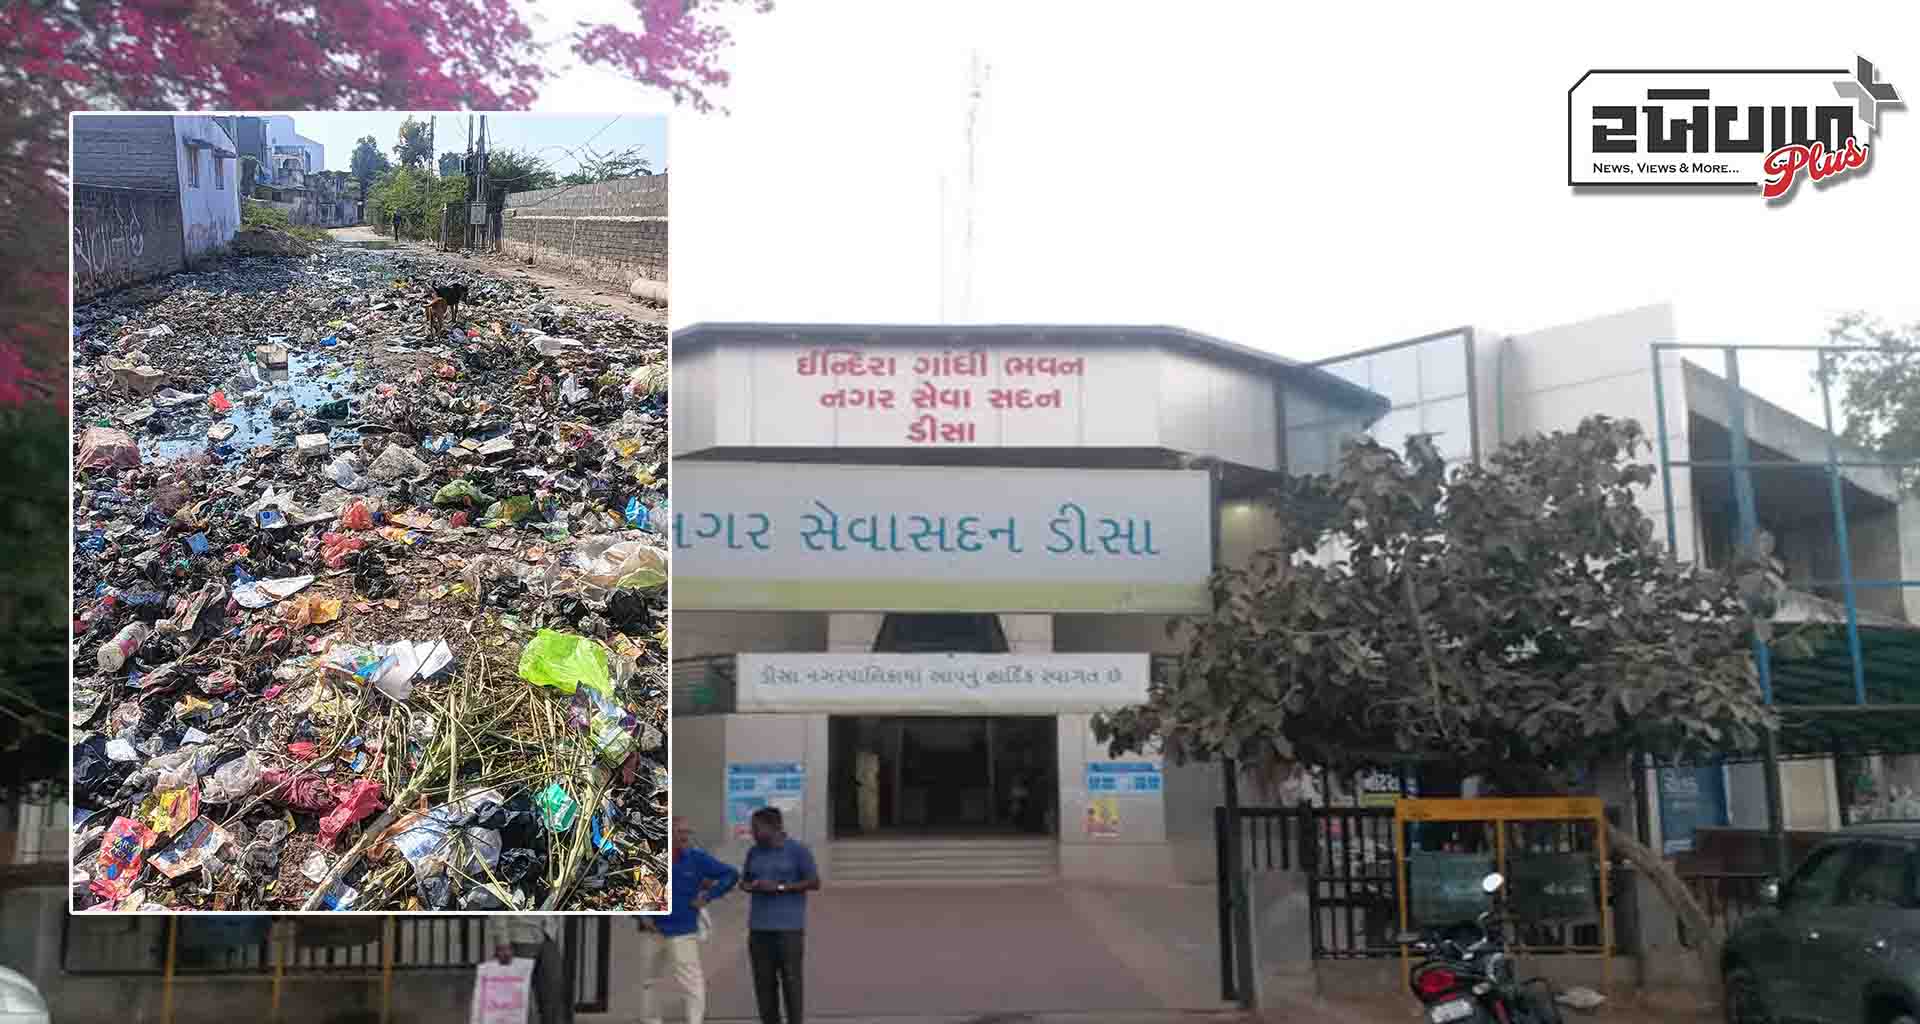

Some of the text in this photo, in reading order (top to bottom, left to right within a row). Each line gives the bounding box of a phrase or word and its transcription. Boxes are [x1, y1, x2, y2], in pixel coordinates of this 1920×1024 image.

[1004, 356, 1085, 376] ભવન
[820, 381, 1062, 409] નગર સેવા સદન
[906, 414, 975, 443] ડીસા
[799, 500, 1024, 552] સેવાસદન
[1047, 502, 1160, 555] ડીસા
